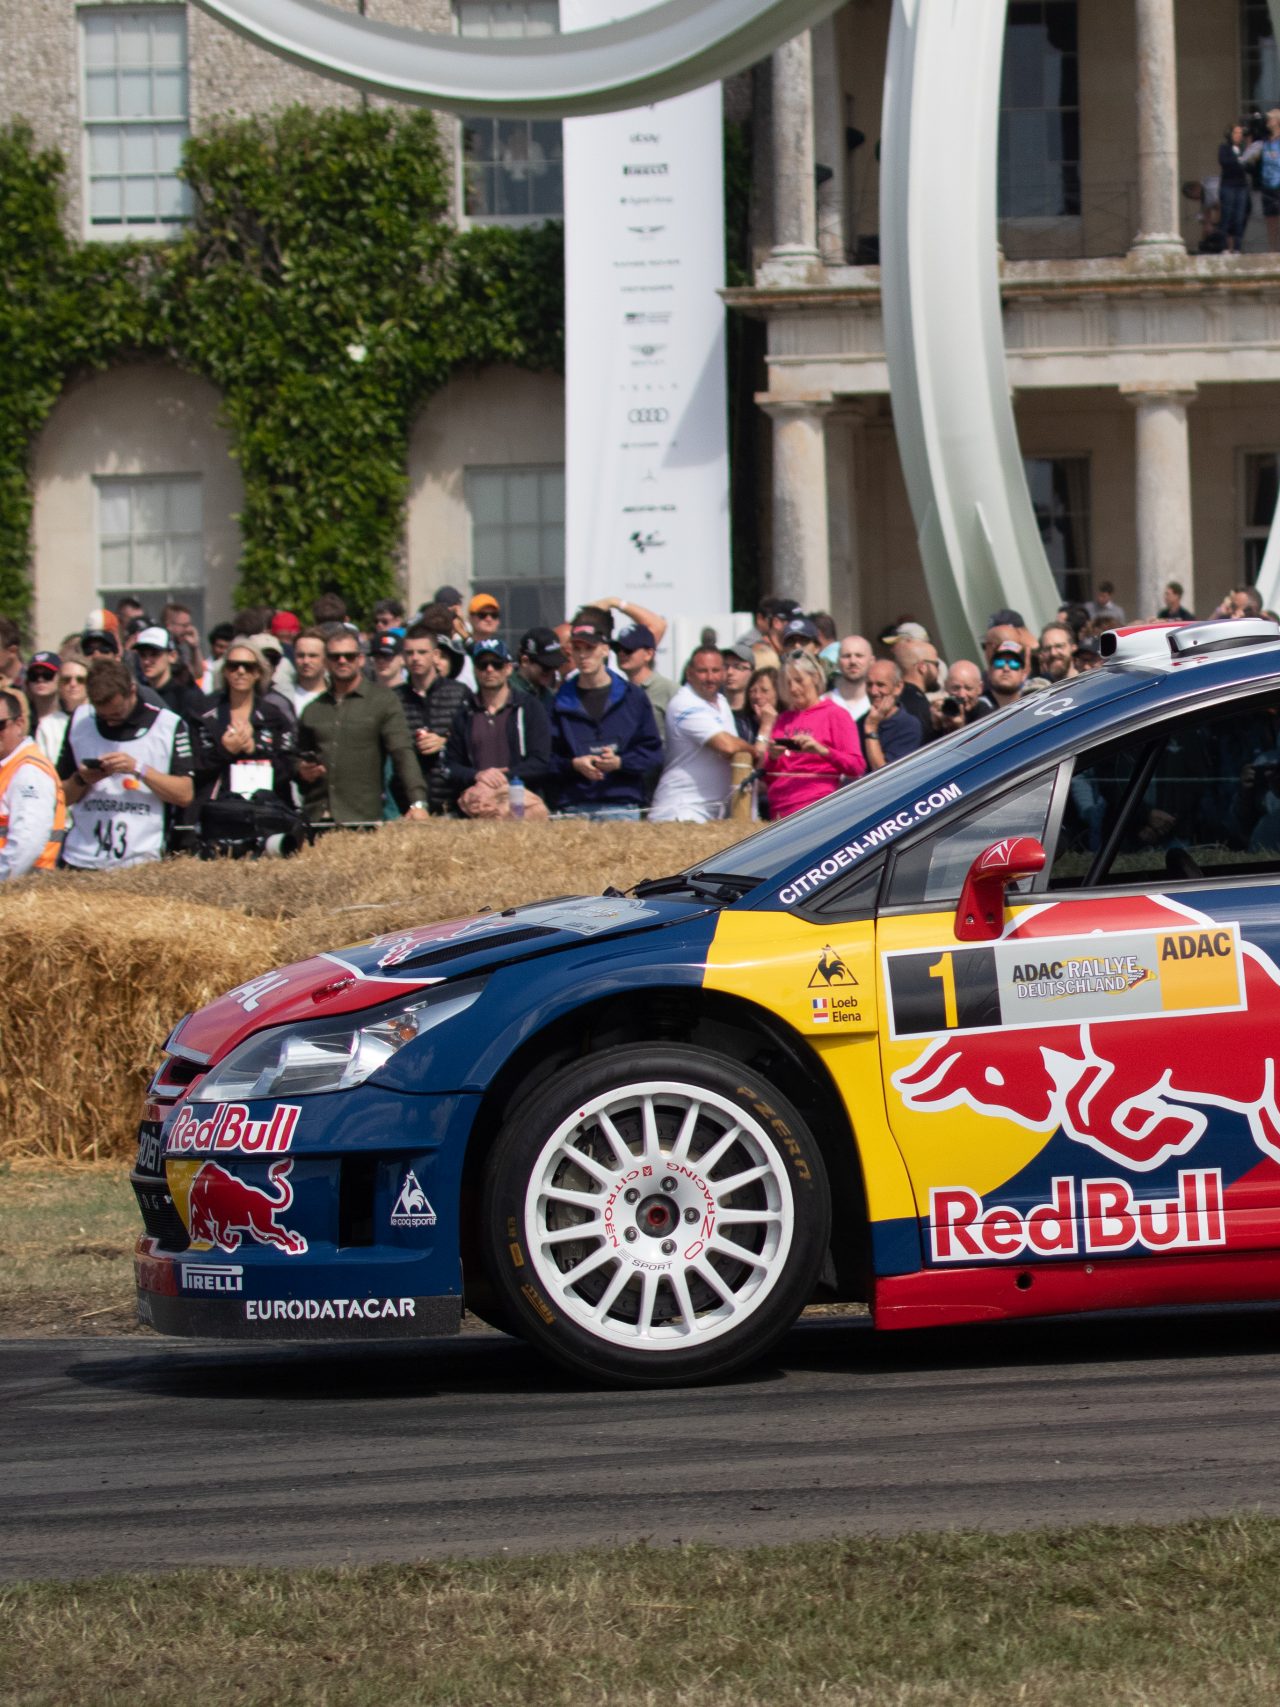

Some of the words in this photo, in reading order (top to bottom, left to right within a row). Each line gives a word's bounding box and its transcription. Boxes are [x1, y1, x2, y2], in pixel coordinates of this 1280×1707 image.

[779, 783, 963, 904] CITROEN-WRC.COM
[1161, 932, 1231, 960] ADAC
[1012, 961, 1064, 982] ADAC
[1066, 956, 1139, 979] RALLYE
[929, 951, 958, 1028] 1
[1017, 976, 1126, 998] DEUTSCHLAND
[831, 997, 857, 1009] Loeb
[832, 1011, 861, 1023] Elena
[167, 1103, 228, 1151] Red
[214, 1103, 302, 1152] Bull
[929, 1176, 1078, 1261] Red
[1082, 1168, 1225, 1253] Bull
[182, 1264, 243, 1290] PIRELLI
[632, 1259, 673, 1271] SPORT
[246, 1298, 416, 1320] EURODATACAR
